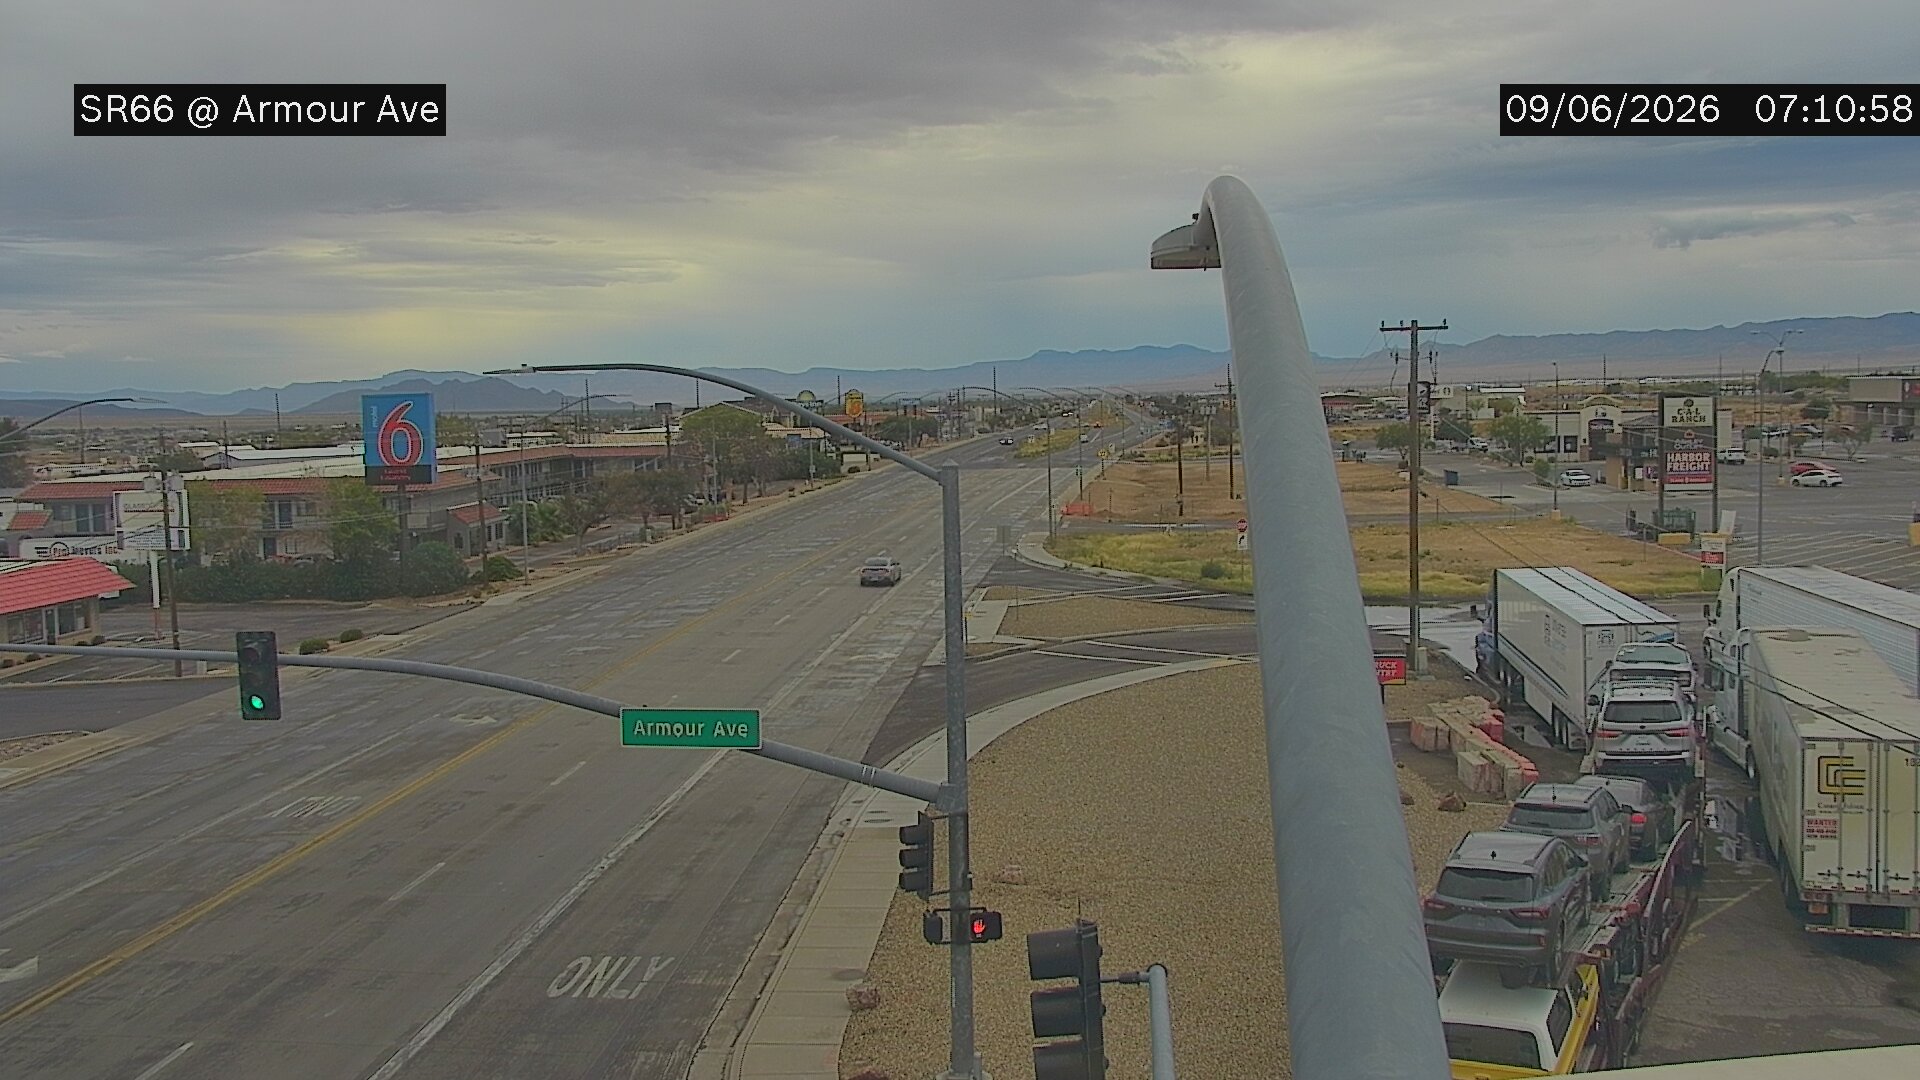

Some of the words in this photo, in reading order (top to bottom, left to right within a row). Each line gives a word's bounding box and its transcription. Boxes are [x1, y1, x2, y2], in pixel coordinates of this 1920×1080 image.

[378, 400, 424, 466] 6
[1667, 453, 1711, 462] HARBOR
[1667, 462, 1711, 471] FREIGHT
[633, 719, 705, 738] Armour
[713, 721, 749, 738] Ave
[546, 955, 676, 1000] ONLY
